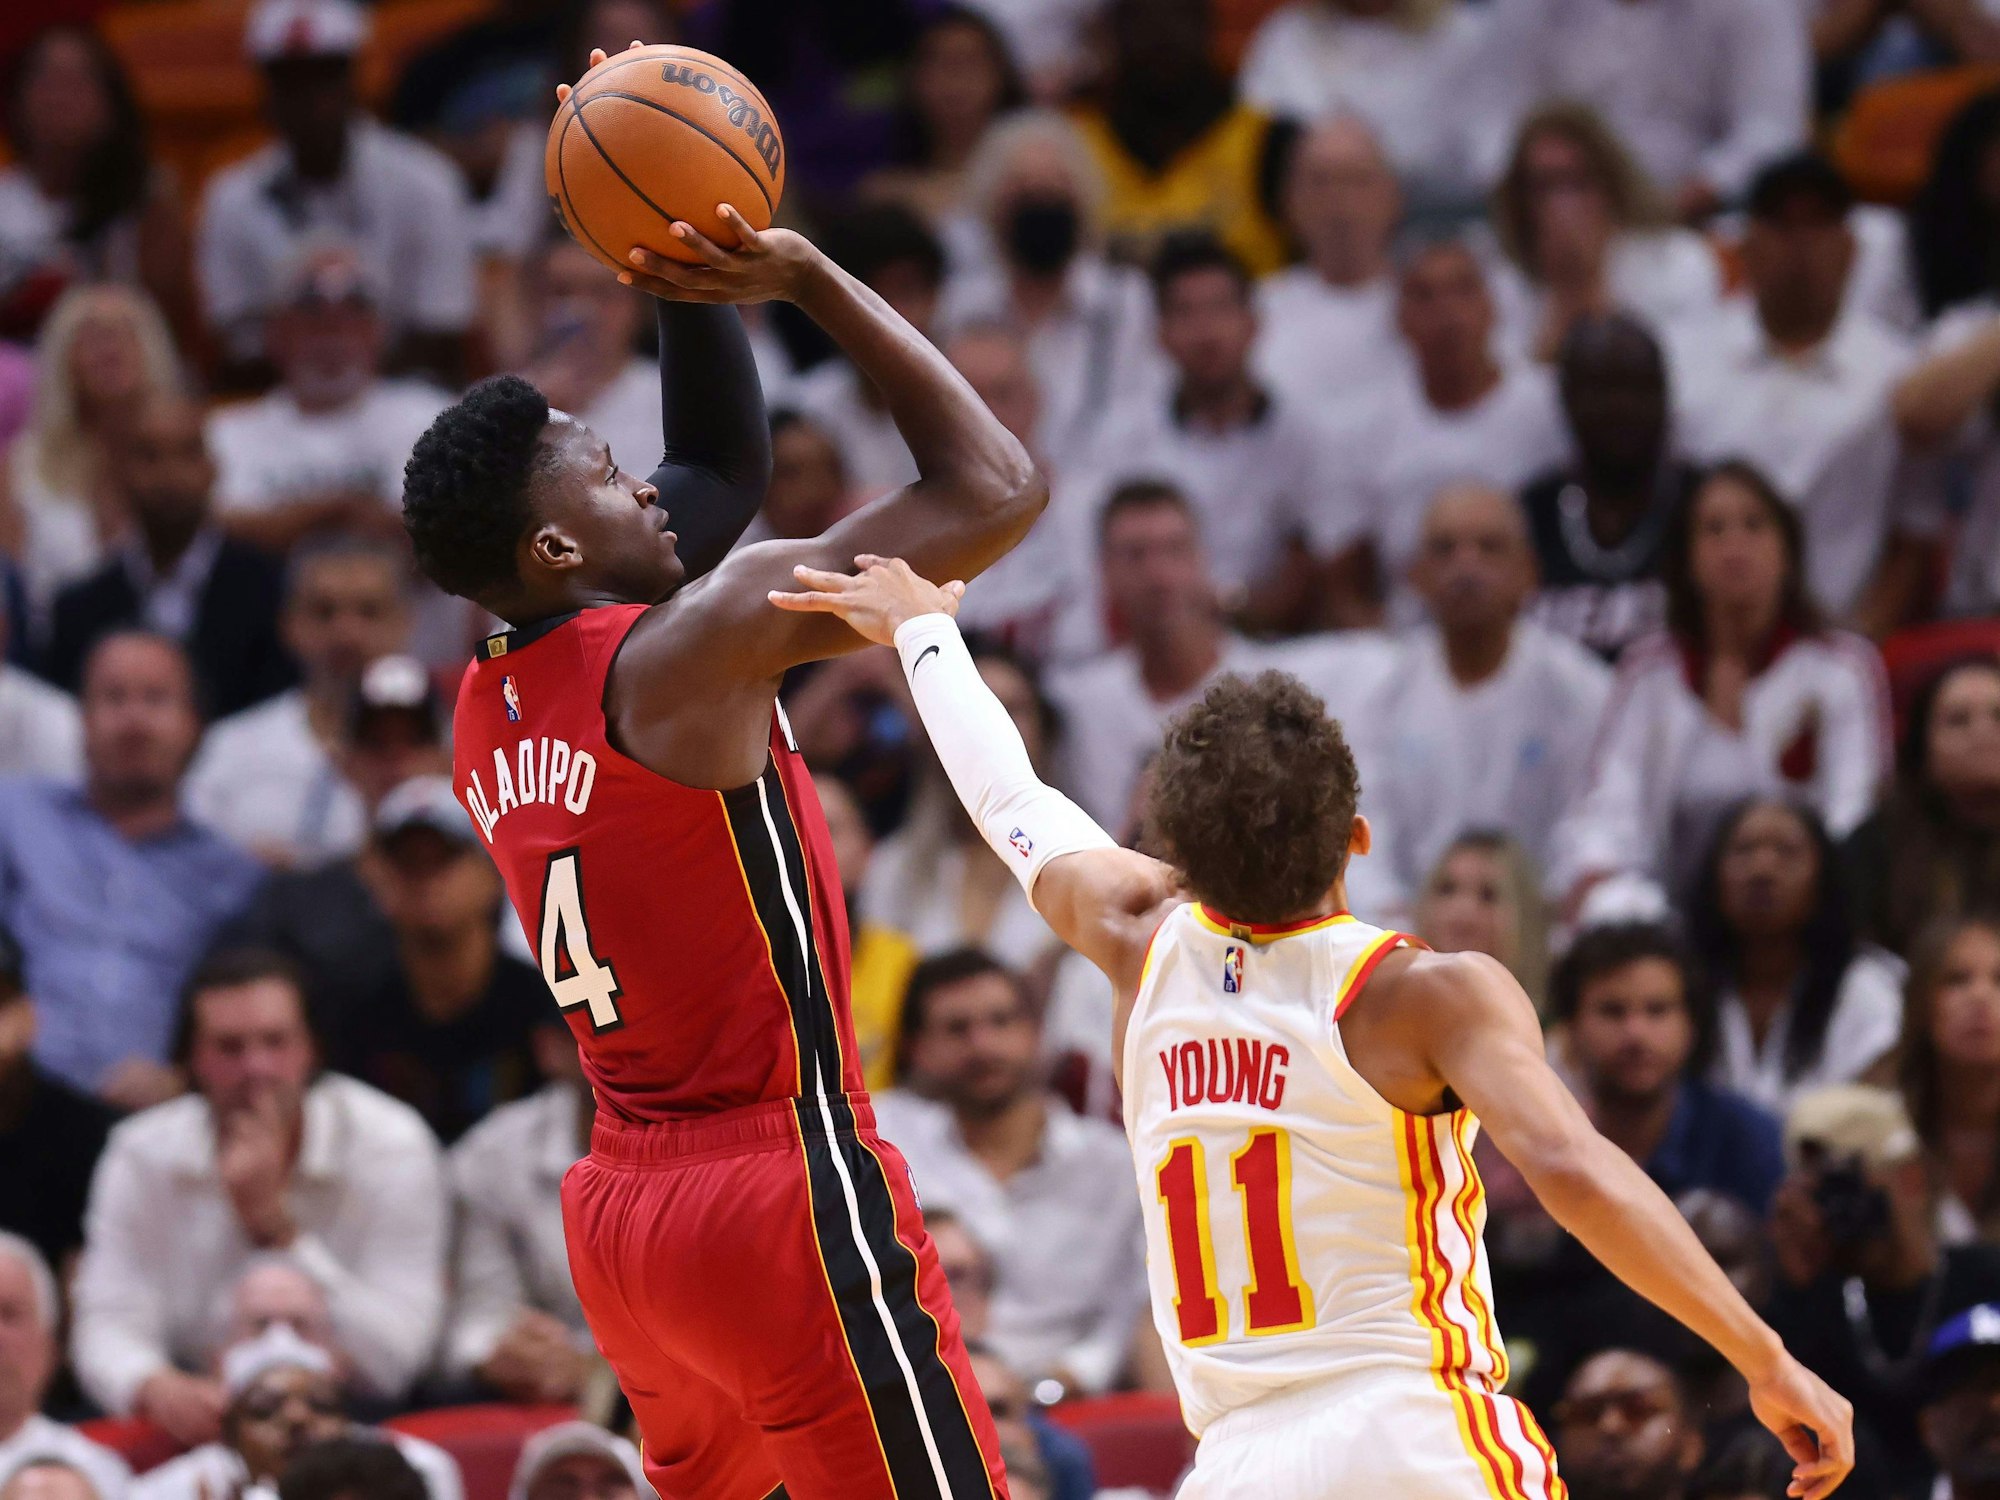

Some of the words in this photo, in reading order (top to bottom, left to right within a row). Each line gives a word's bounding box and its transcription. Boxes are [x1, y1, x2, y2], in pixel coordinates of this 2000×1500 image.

[661, 62, 781, 181] Wilson
[466, 736, 597, 844] OLADIPO
[538, 846, 624, 1035] 4
[1159, 1037, 1290, 1111] YOUNG
[1154, 1125, 1316, 1348] 11
